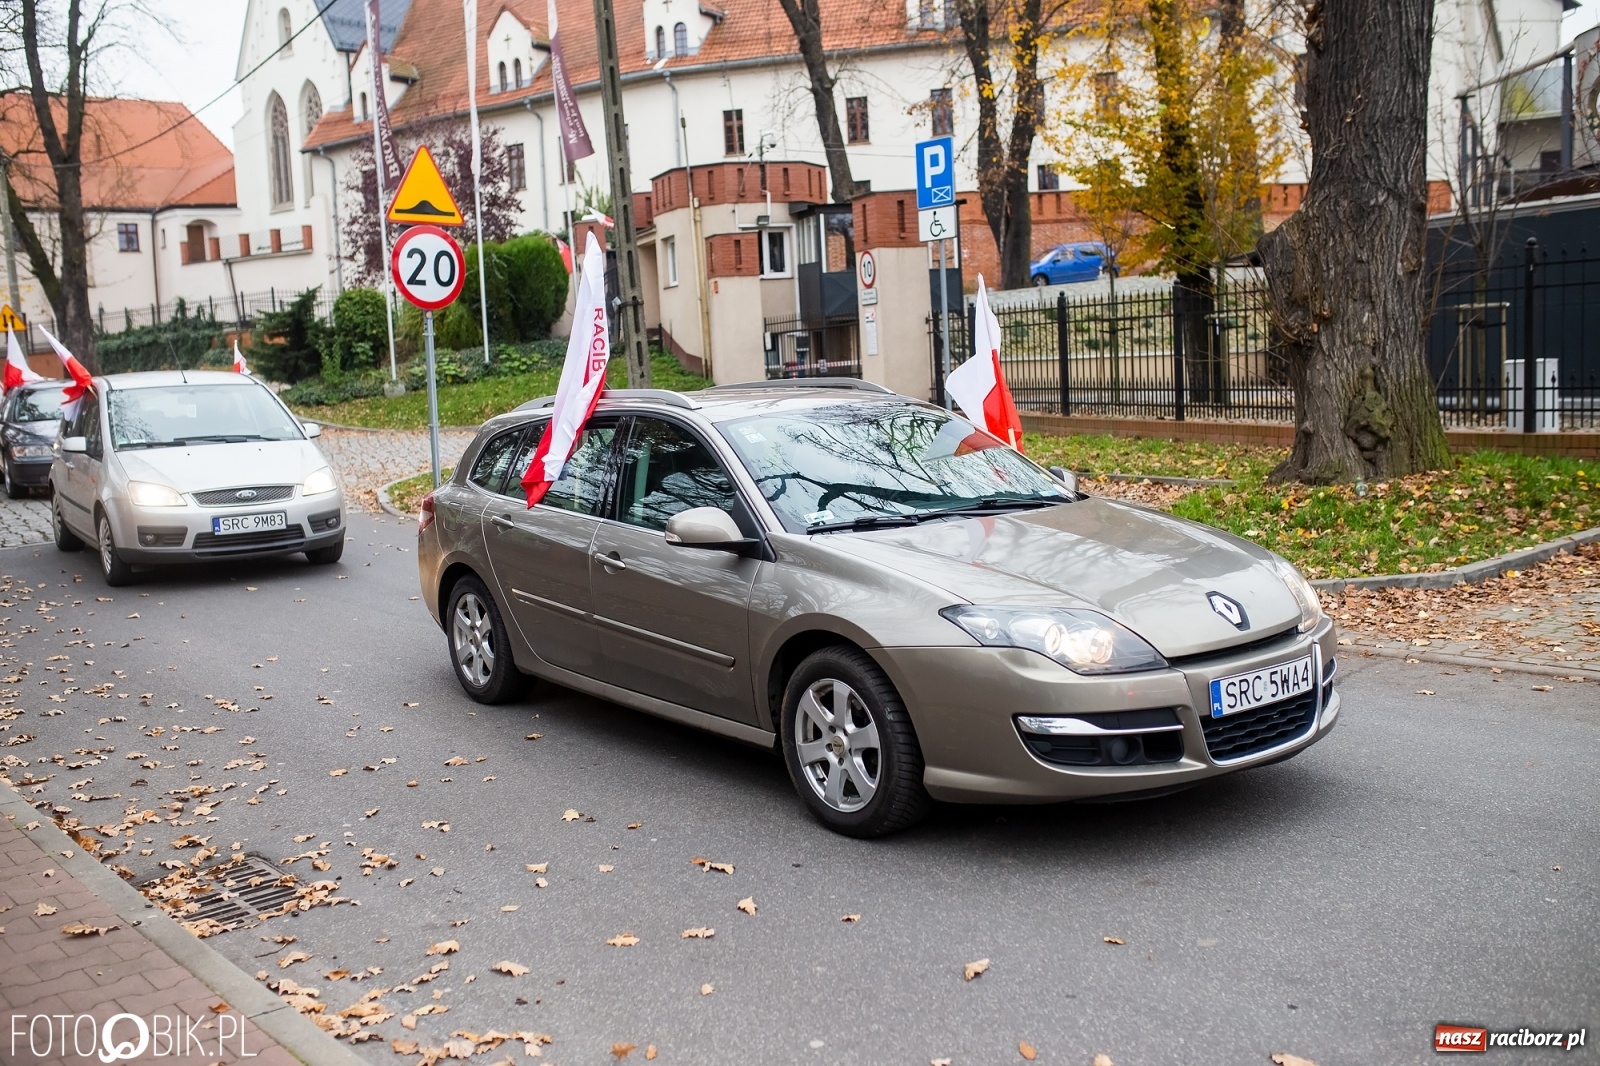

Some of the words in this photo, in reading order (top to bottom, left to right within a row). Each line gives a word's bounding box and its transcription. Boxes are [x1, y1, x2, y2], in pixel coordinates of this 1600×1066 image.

[923, 144, 945, 188] P
[406, 247, 456, 287] 20
[862, 260, 872, 278] 10
[222, 517, 250, 531] SRC
[253, 514, 284, 529] 9M83
[1225, 675, 1263, 709] SRC
[1269, 660, 1310, 699] 5WA4
[1213, 702, 1222, 711] PL
